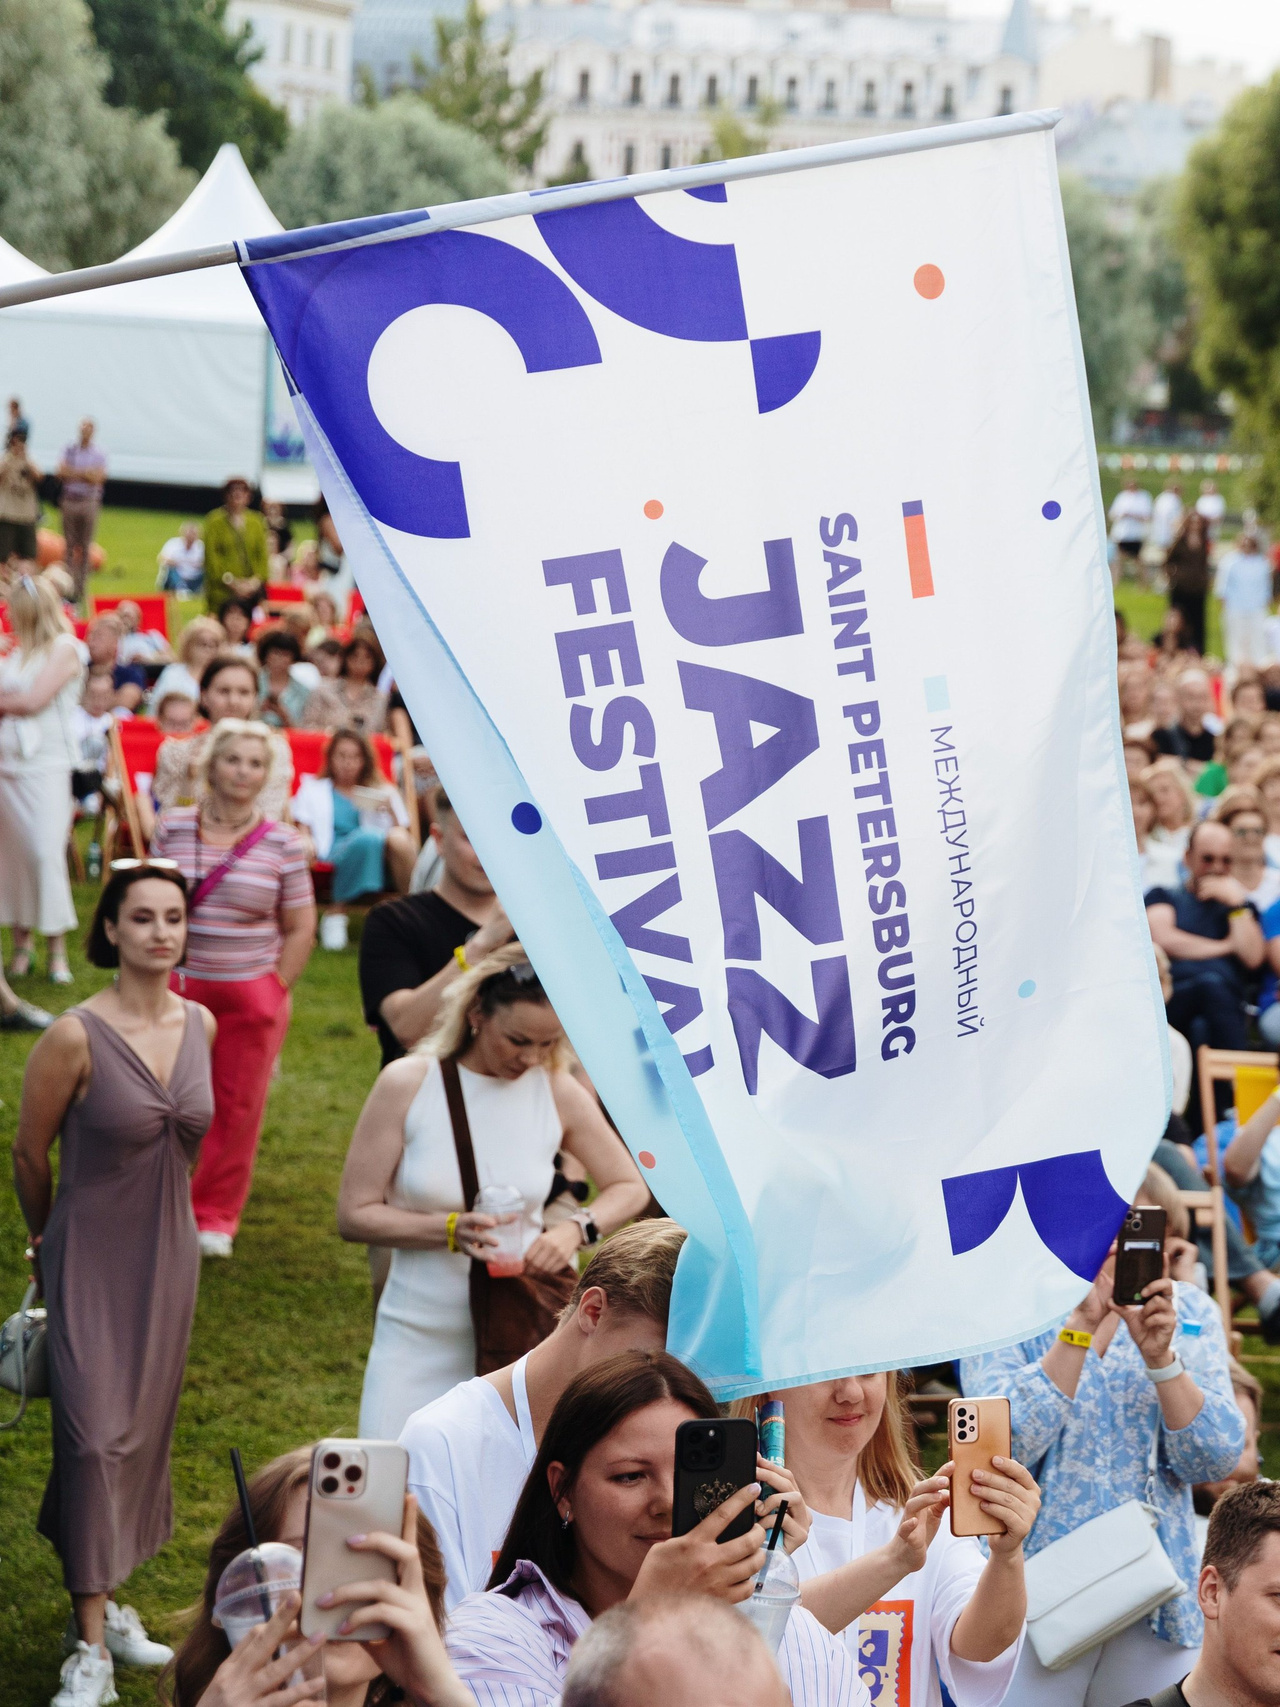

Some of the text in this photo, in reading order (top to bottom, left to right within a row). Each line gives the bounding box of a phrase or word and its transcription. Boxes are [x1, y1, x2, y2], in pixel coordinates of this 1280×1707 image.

[660, 537, 857, 1096] JAZZ
[819, 512, 917, 1062] SAINT PETERSBURG
[930, 725, 985, 1038] МЕЖДУНАРОДНЫЙ
